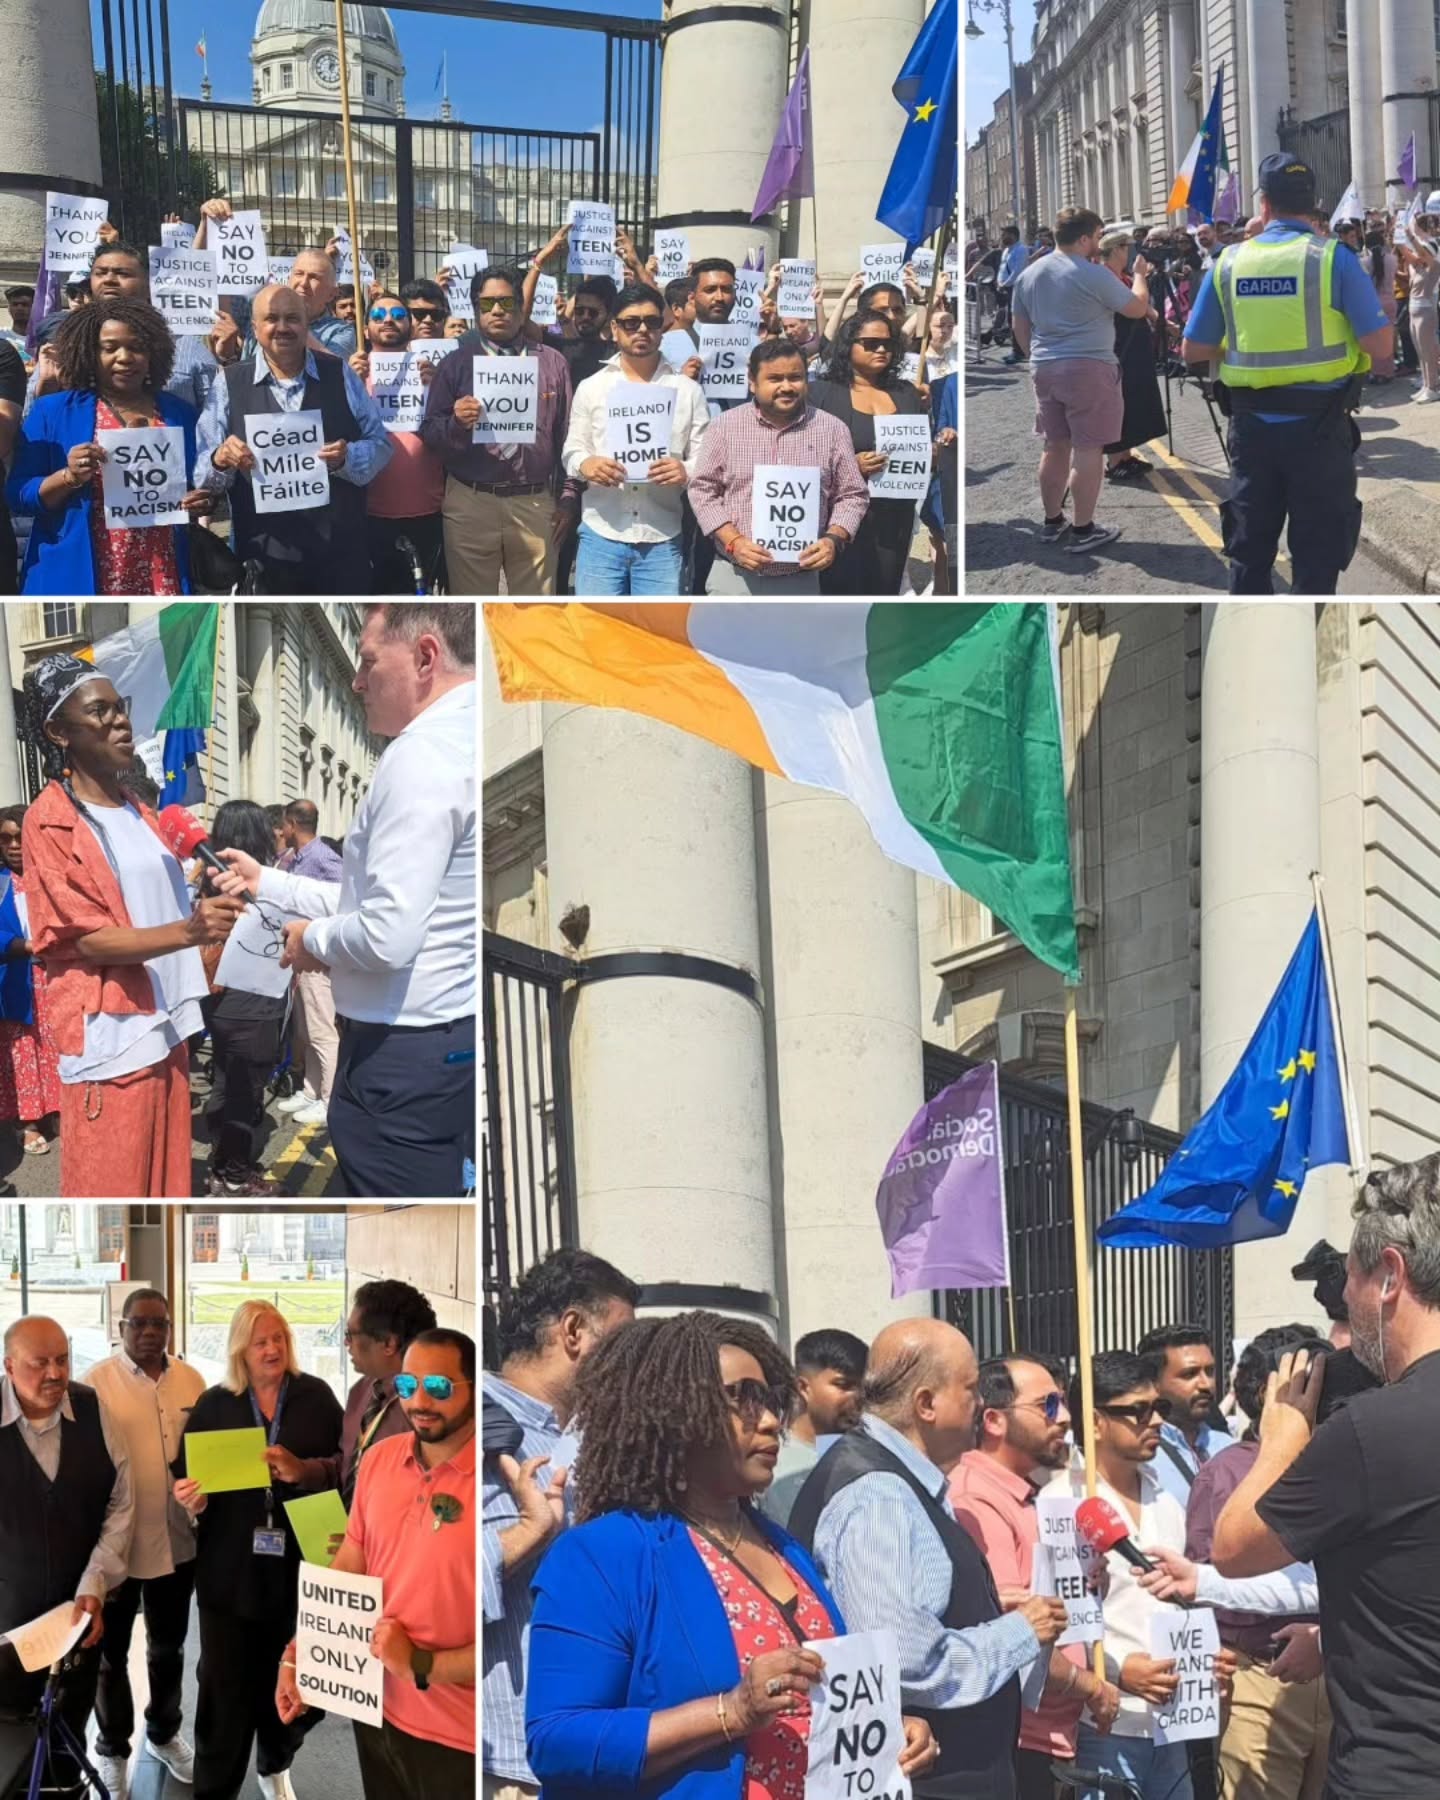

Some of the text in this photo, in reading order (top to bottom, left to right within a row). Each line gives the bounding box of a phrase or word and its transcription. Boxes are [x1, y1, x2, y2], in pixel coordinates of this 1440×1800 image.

[50, 206, 104, 220] THANK
[574, 209, 611, 221] JUSTICE
[55, 228, 97, 244] YOU
[218, 224, 254, 240] SAY
[572, 224, 612, 234] AGAINST
[573, 240, 611, 253] TEEN
[660, 238, 685, 249] SAY
[48, 251, 94, 260] JENNIFE
[222, 245, 254, 260] NO
[663, 251, 683, 262] NO
[154, 258, 211, 272] JUSTICE
[570, 258, 611, 267] VIOLENCE
[666, 263, 678, 271] TO
[864, 254, 902, 266] Céad
[228, 263, 248, 274] TO
[783, 265, 816, 276] UNITED
[154, 276, 213, 289] AGAINST
[1238, 280, 1294, 294] GARDA
[156, 294, 212, 309] TEEN
[534, 295, 553, 305] OU
[784, 292, 810, 301] ONLY
[166, 316, 215, 325] IOLENCE
[737, 310, 749, 319] TO
[703, 337, 749, 347] IRELAND
[715, 352, 735, 369] IS
[376, 378, 419, 387] AGAINS
[477, 372, 534, 385] THANK
[700, 374, 745, 385] HOME
[376, 394, 424, 408] TEEN
[483, 398, 529, 413] YOU
[609, 403, 666, 418] IRELAND
[475, 422, 534, 431] JENNIFER
[627, 422, 651, 444] IS
[881, 426, 926, 436] JUSTICE
[252, 425, 317, 449] Céad
[115, 442, 170, 464] SAY
[881, 442, 928, 451] AGAINST
[614, 447, 667, 464] HOME
[263, 453, 315, 476] Míle
[888, 460, 926, 474] EEN
[123, 469, 168, 488] NO
[873, 480, 926, 490] VIOLENCE
[133, 490, 160, 502] TO
[260, 480, 325, 501] Fáilte
[765, 481, 811, 499] SAY
[111, 502, 183, 518] RACISM
[770, 505, 805, 522] NO
[776, 525, 797, 538] TO
[1045, 1517, 1080, 1533] JUSTI
[1055, 1545, 1097, 1560] GAINST
[302, 1580, 377, 1612] UNITED
[1069, 1611, 1102, 1625] LENCE
[1169, 1628, 1203, 1651] WE
[310, 1645, 367, 1675] ONLY
[1177, 1654, 1214, 1673] AND
[299, 1673, 378, 1709] SOLUTION
[829, 1664, 883, 1713] SAY
[1167, 1679, 1214, 1704] ITH
[1158, 1706, 1216, 1729] GARDA
[833, 1719, 887, 1765] NO
[843, 1767, 875, 1797] TO
